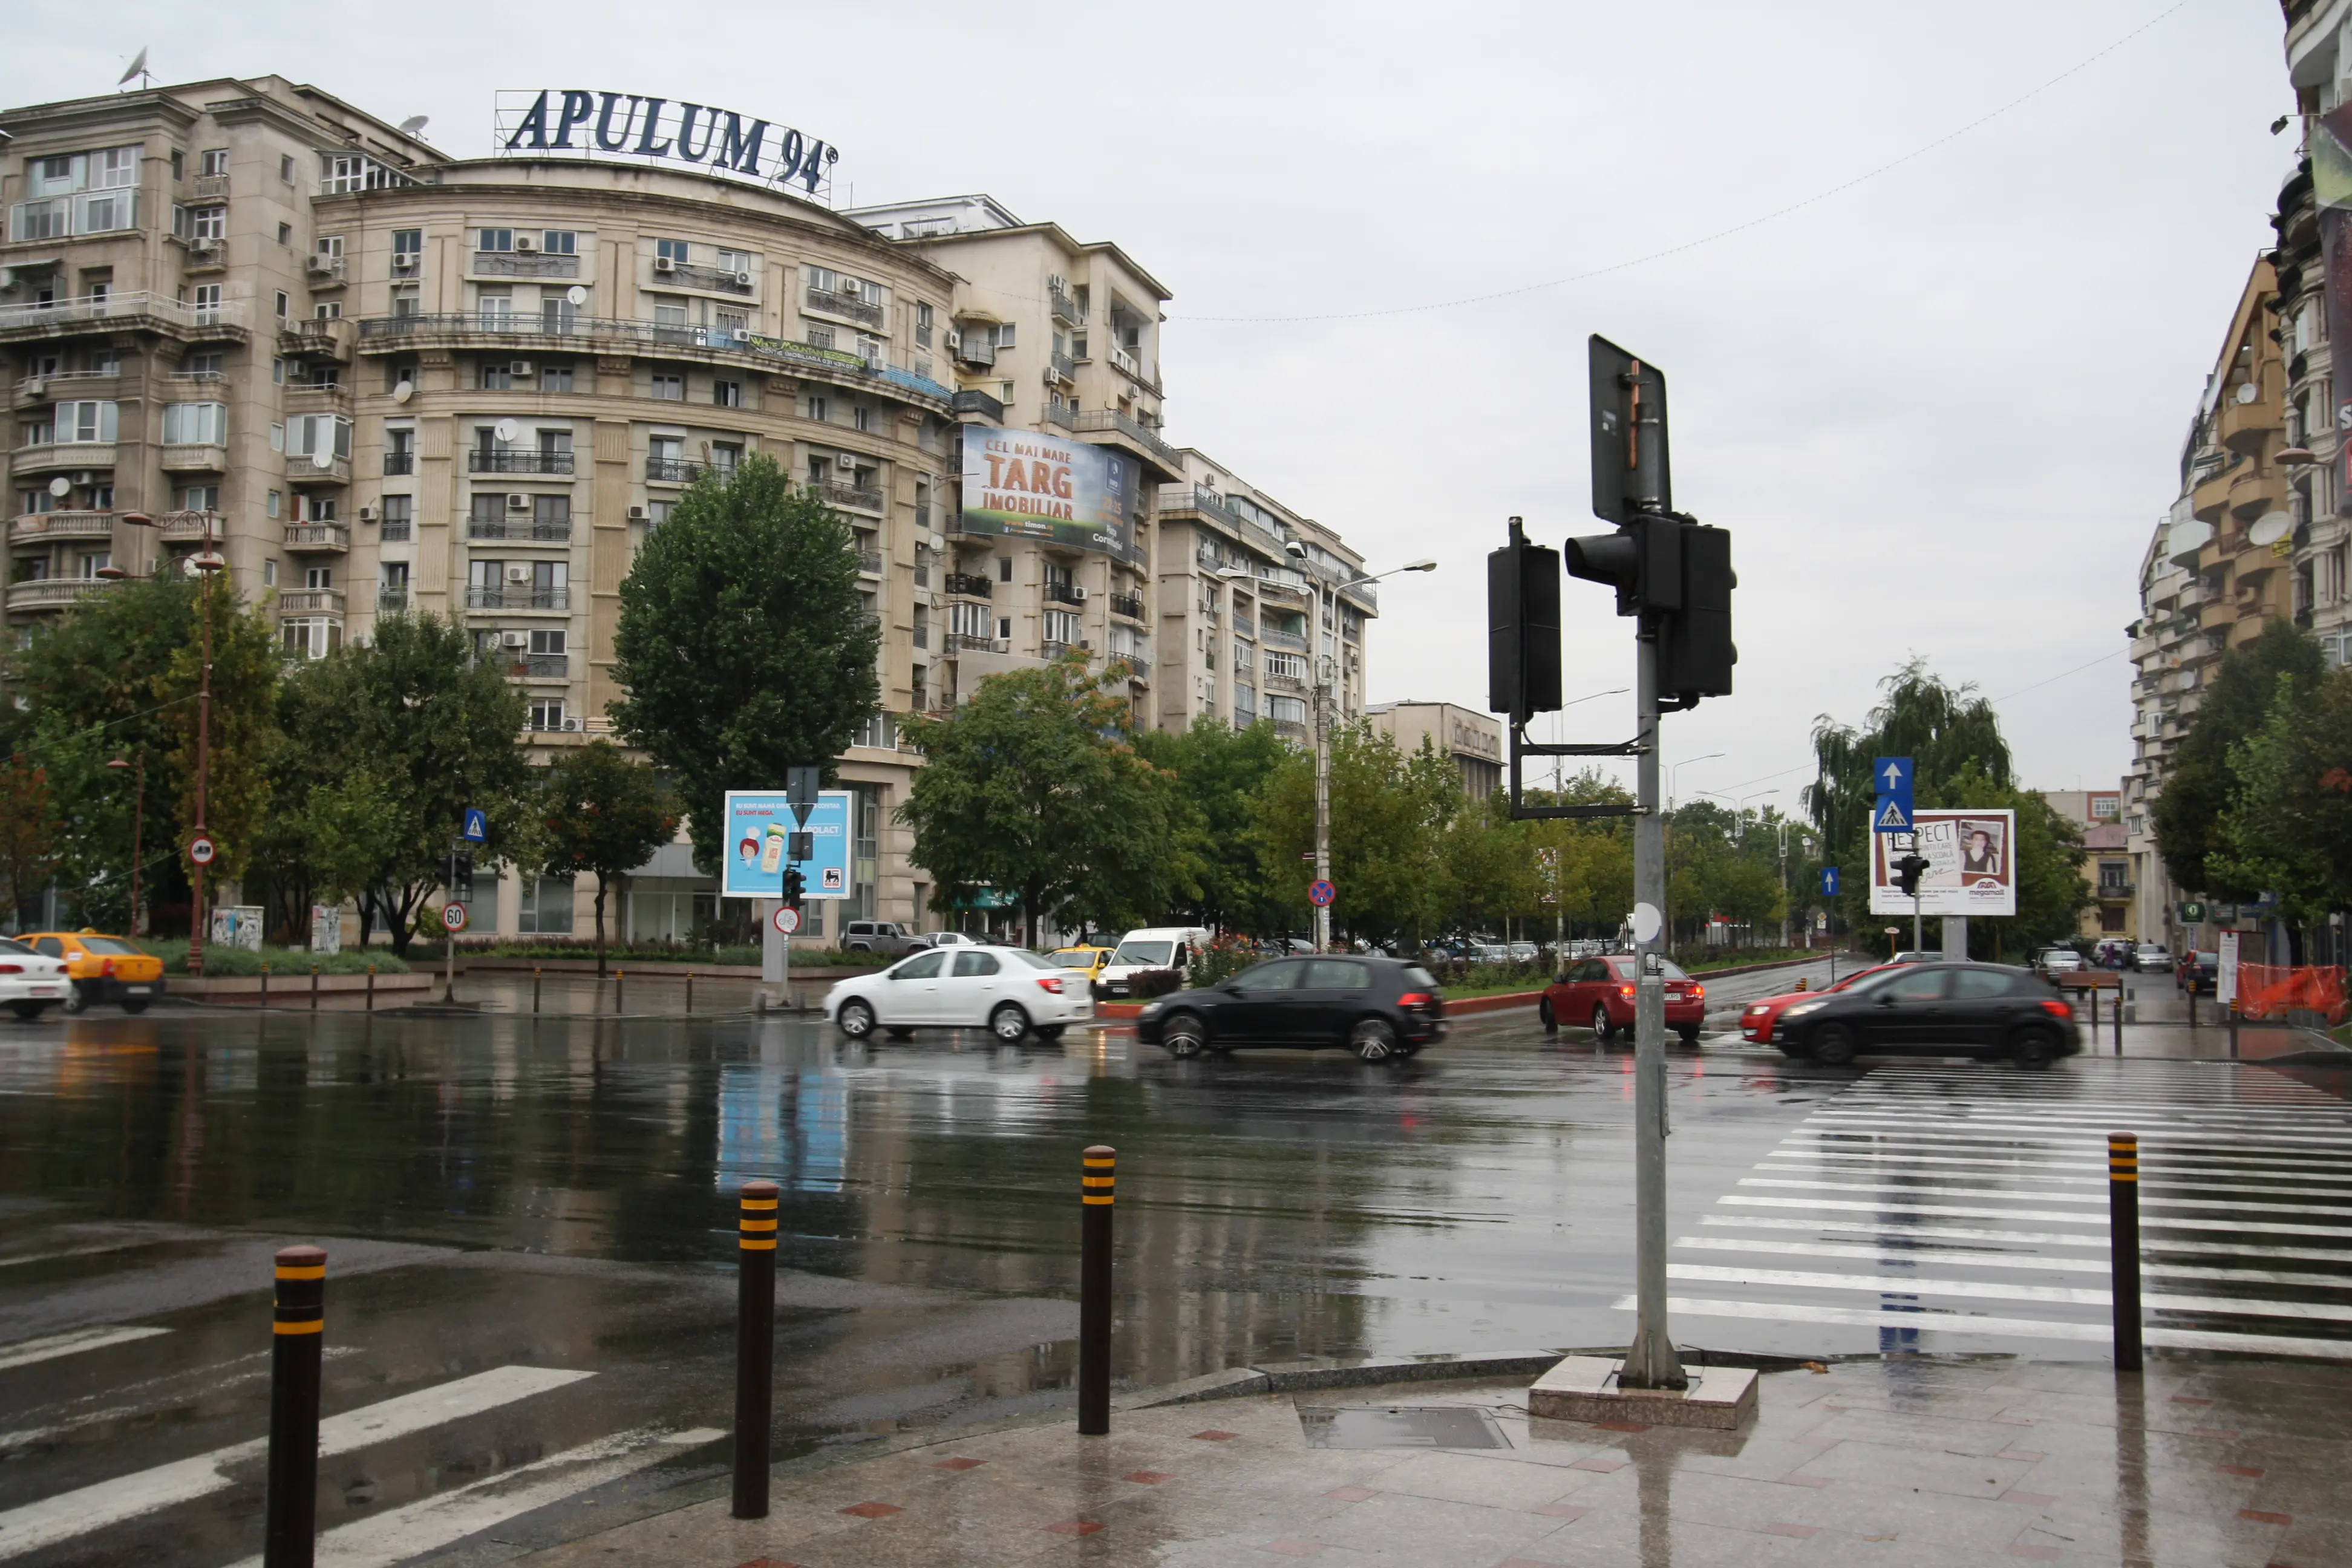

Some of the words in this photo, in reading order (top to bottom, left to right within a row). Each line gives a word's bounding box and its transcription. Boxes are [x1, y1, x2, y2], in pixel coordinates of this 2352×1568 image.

[506, 89, 769, 176] APULUM
[985, 440, 1009, 452] CEL
[1014, 443, 1037, 457] MAI
[1042, 447, 1071, 464] MARE
[984, 453, 1073, 500] TARG
[983, 492, 1073, 521] IMOBILIAR
[448, 909, 461, 924] 60
